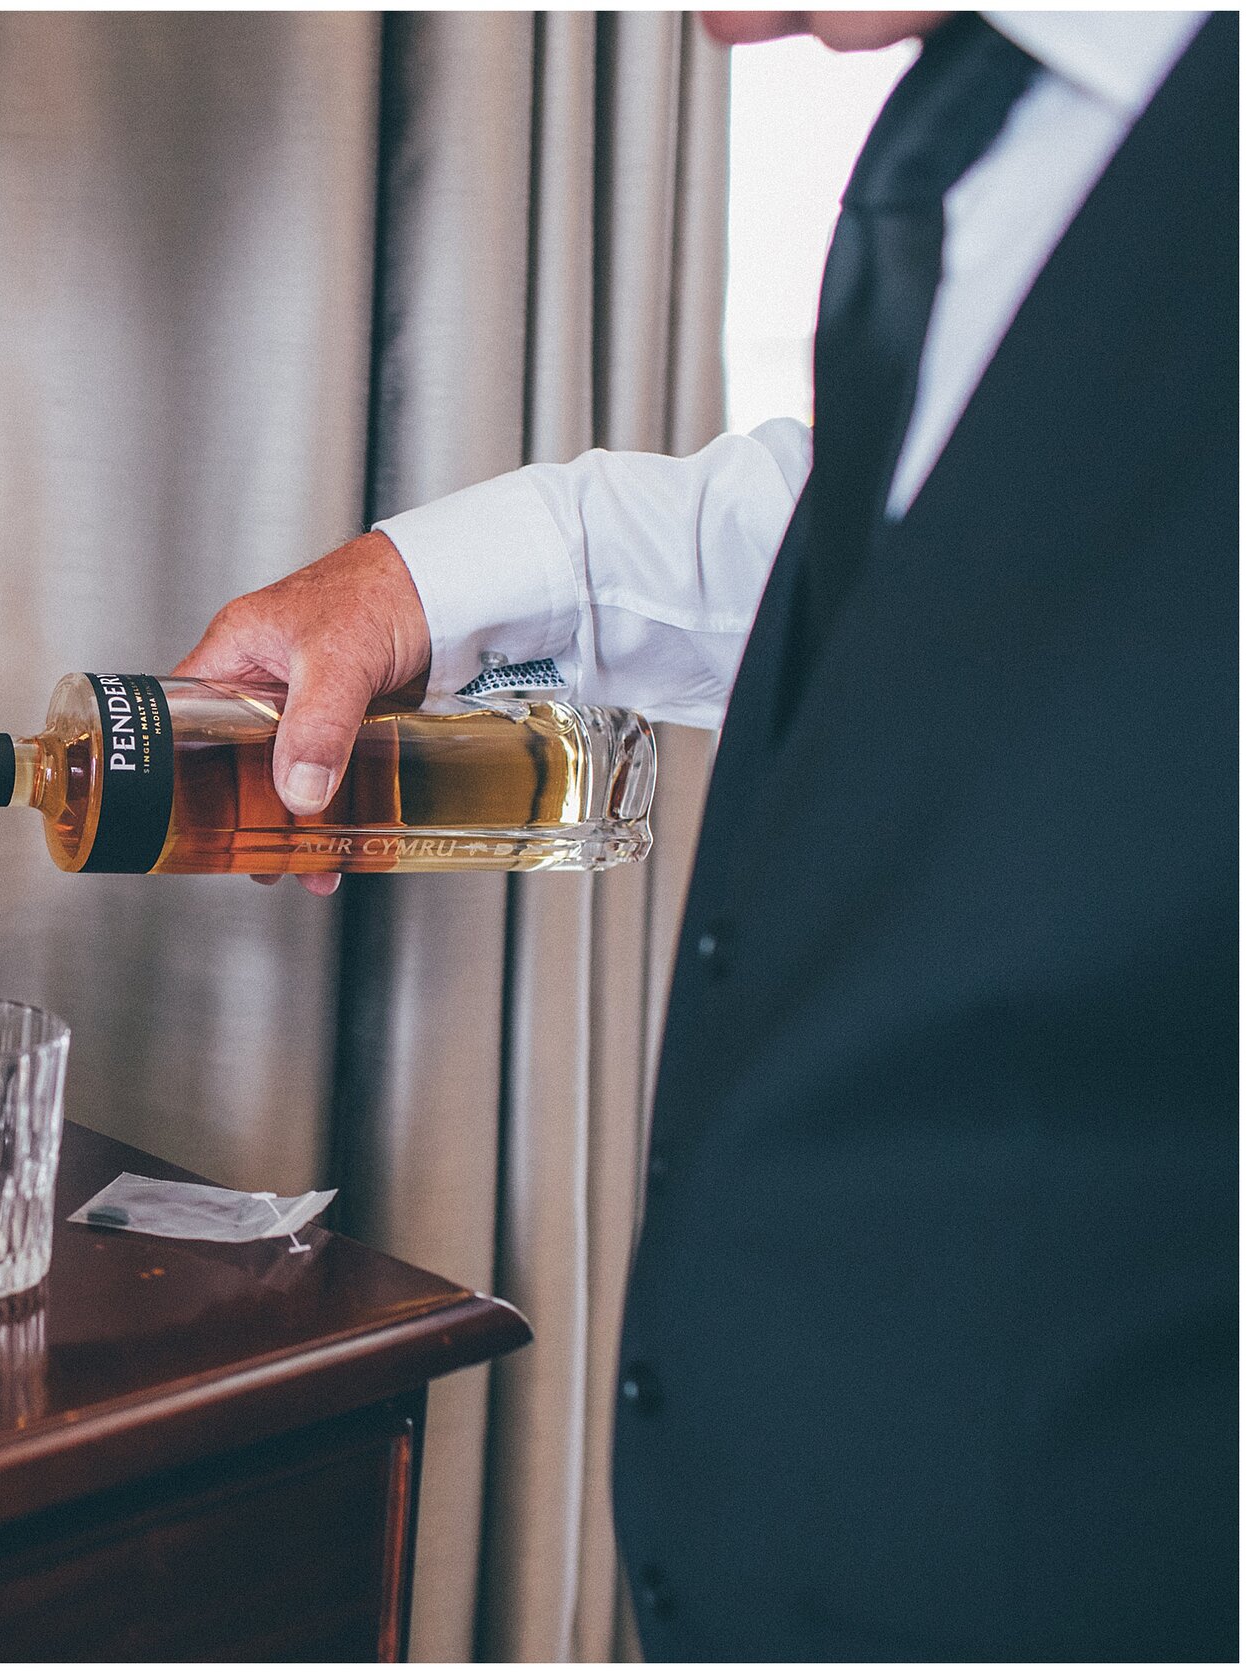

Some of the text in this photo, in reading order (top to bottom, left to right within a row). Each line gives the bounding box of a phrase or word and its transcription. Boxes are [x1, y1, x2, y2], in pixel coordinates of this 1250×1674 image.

[138, 705, 148, 730] MALT
[149, 698, 161, 735] MADEIRA
[142, 734, 150, 774] SINGLE
[362, 836, 458, 857] CYMRU
